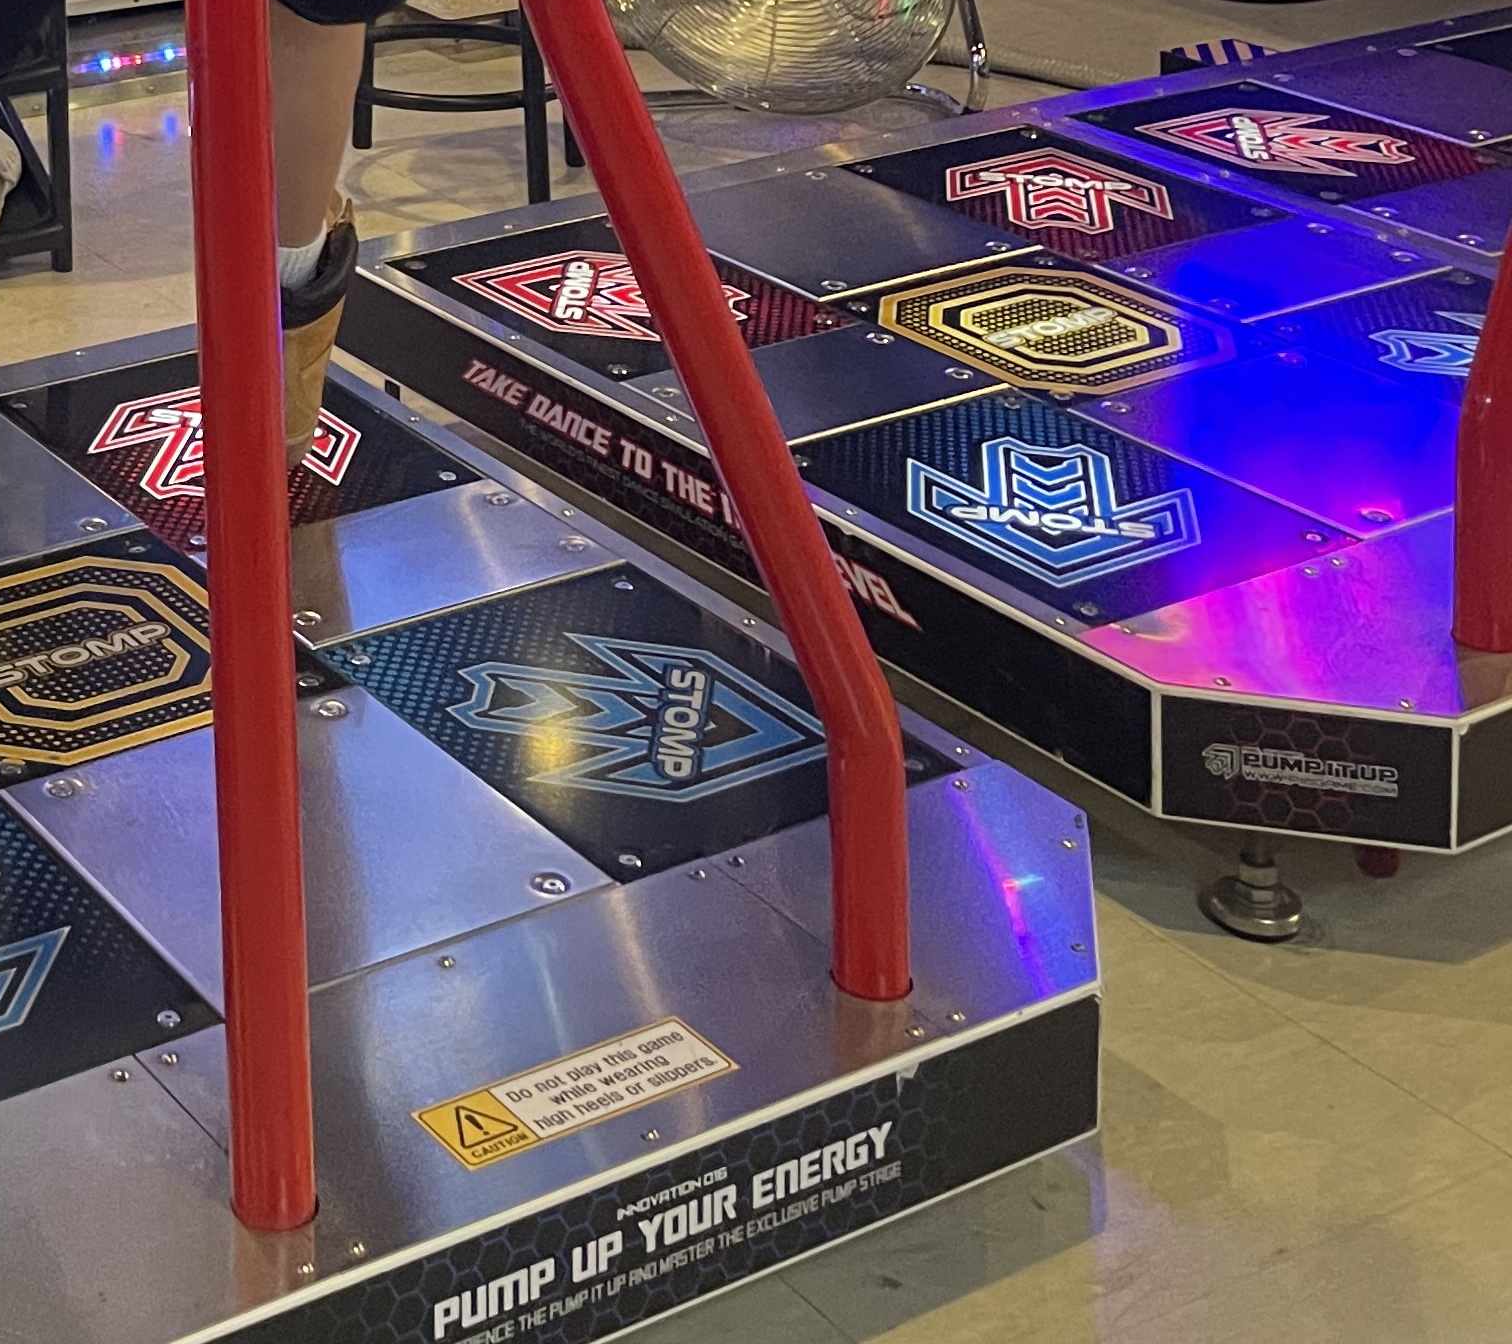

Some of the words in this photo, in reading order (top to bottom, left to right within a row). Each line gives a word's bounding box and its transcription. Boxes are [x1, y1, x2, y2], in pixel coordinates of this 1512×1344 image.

[977, 169, 1133, 192] STOMP
[556, 255, 599, 323] STOMP
[987, 305, 1119, 350] STOMP
[464, 360, 528, 405] TAKE
[528, 393, 611, 455] DANCE
[620, 438, 655, 482] TO
[661, 461, 718, 513] THE
[948, 498, 1159, 543] STOMP
[835, 551, 923, 633] EVEL
[651, 662, 710, 787] STOMP
[1243, 749, 1324, 773] PUMP
[1327, 762, 1355, 779] IT
[1359, 765, 1399, 783] UP
[505, 1089, 533, 1104] Do
[535, 1075, 567, 1093] not
[566, 1062, 604, 1082] play
[602, 1048, 636, 1067] this
[637, 1030, 684, 1055] game
[548, 1080, 597, 1106] while
[598, 1054, 670, 1087] wearing
[533, 1107, 576, 1130] high
[579, 1090, 624, 1114] heels
[625, 1082, 647, 1097] or
[471, 1131, 530, 1159] CAUTION
[617, 1176, 701, 1222] INNOVATION
[434, 1256, 556, 1341] PUMP
[572, 1230, 623, 1282] UP
[638, 1184, 737, 1253] YOUR
[752, 1120, 894, 1210] ENERGY
[519, 1308, 547, 1333] THE
[548, 1291, 590, 1323] PUMP
[606, 1275, 628, 1297] UP
[628, 1263, 658, 1290] AND
[658, 1238, 716, 1280] MASTER
[716, 1228, 745, 1255] THE
[745, 1197, 820, 1241] EXCLUSIVE
[820, 1181, 859, 1212] PUMP
[859, 1159, 904, 1194] STAGE
